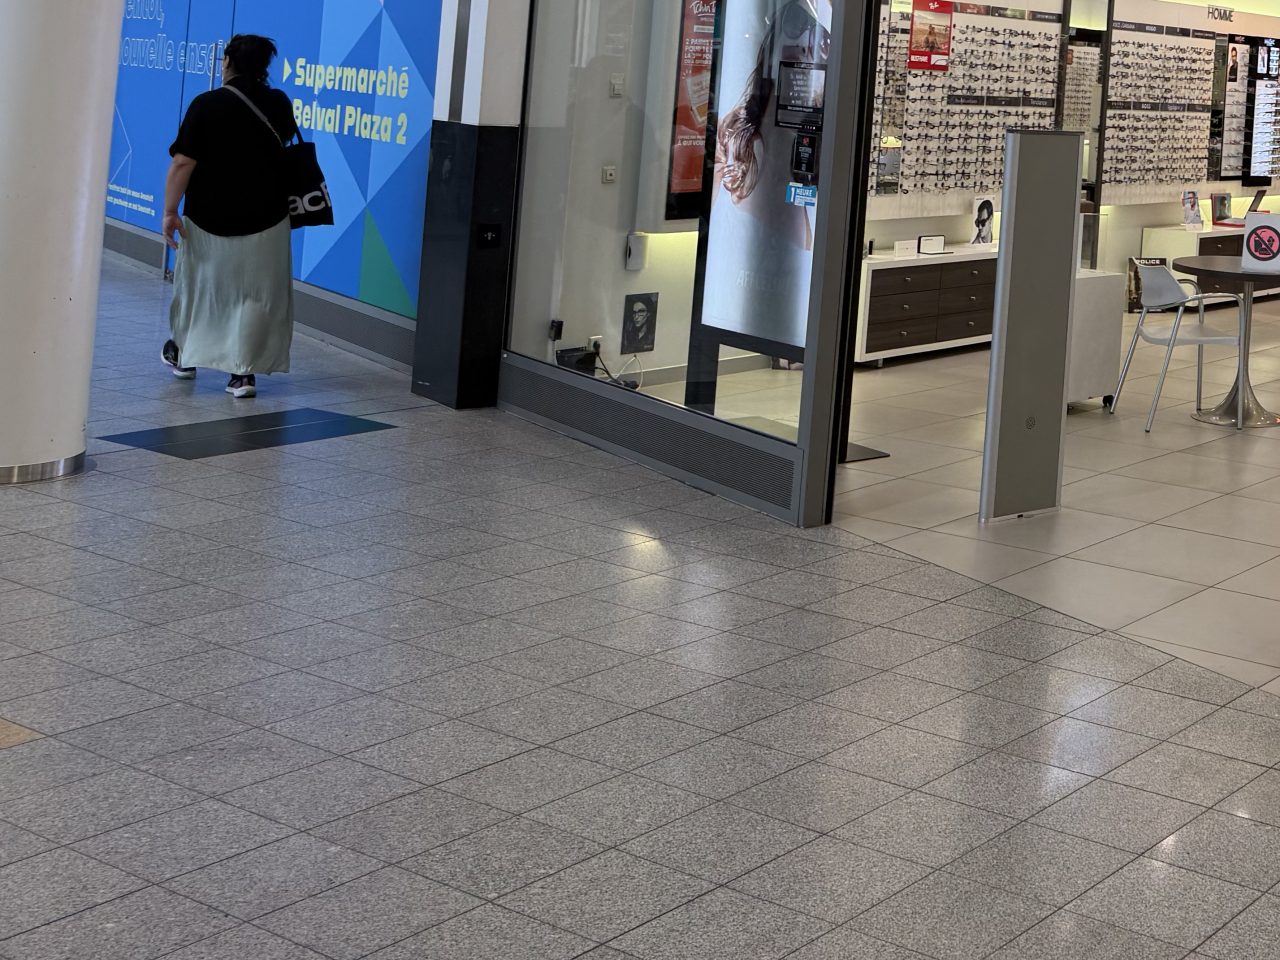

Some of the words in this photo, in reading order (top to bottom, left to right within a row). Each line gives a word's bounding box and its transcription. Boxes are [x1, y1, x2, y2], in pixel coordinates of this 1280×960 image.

[1207, 7, 1234, 23] HOMME
[119, 34, 175, 71] ouvelle
[294, 57, 409, 98] Supermarché
[292, 98, 341, 134] Belval
[343, 105, 393, 142] Plaza
[396, 112, 408, 145] 2
